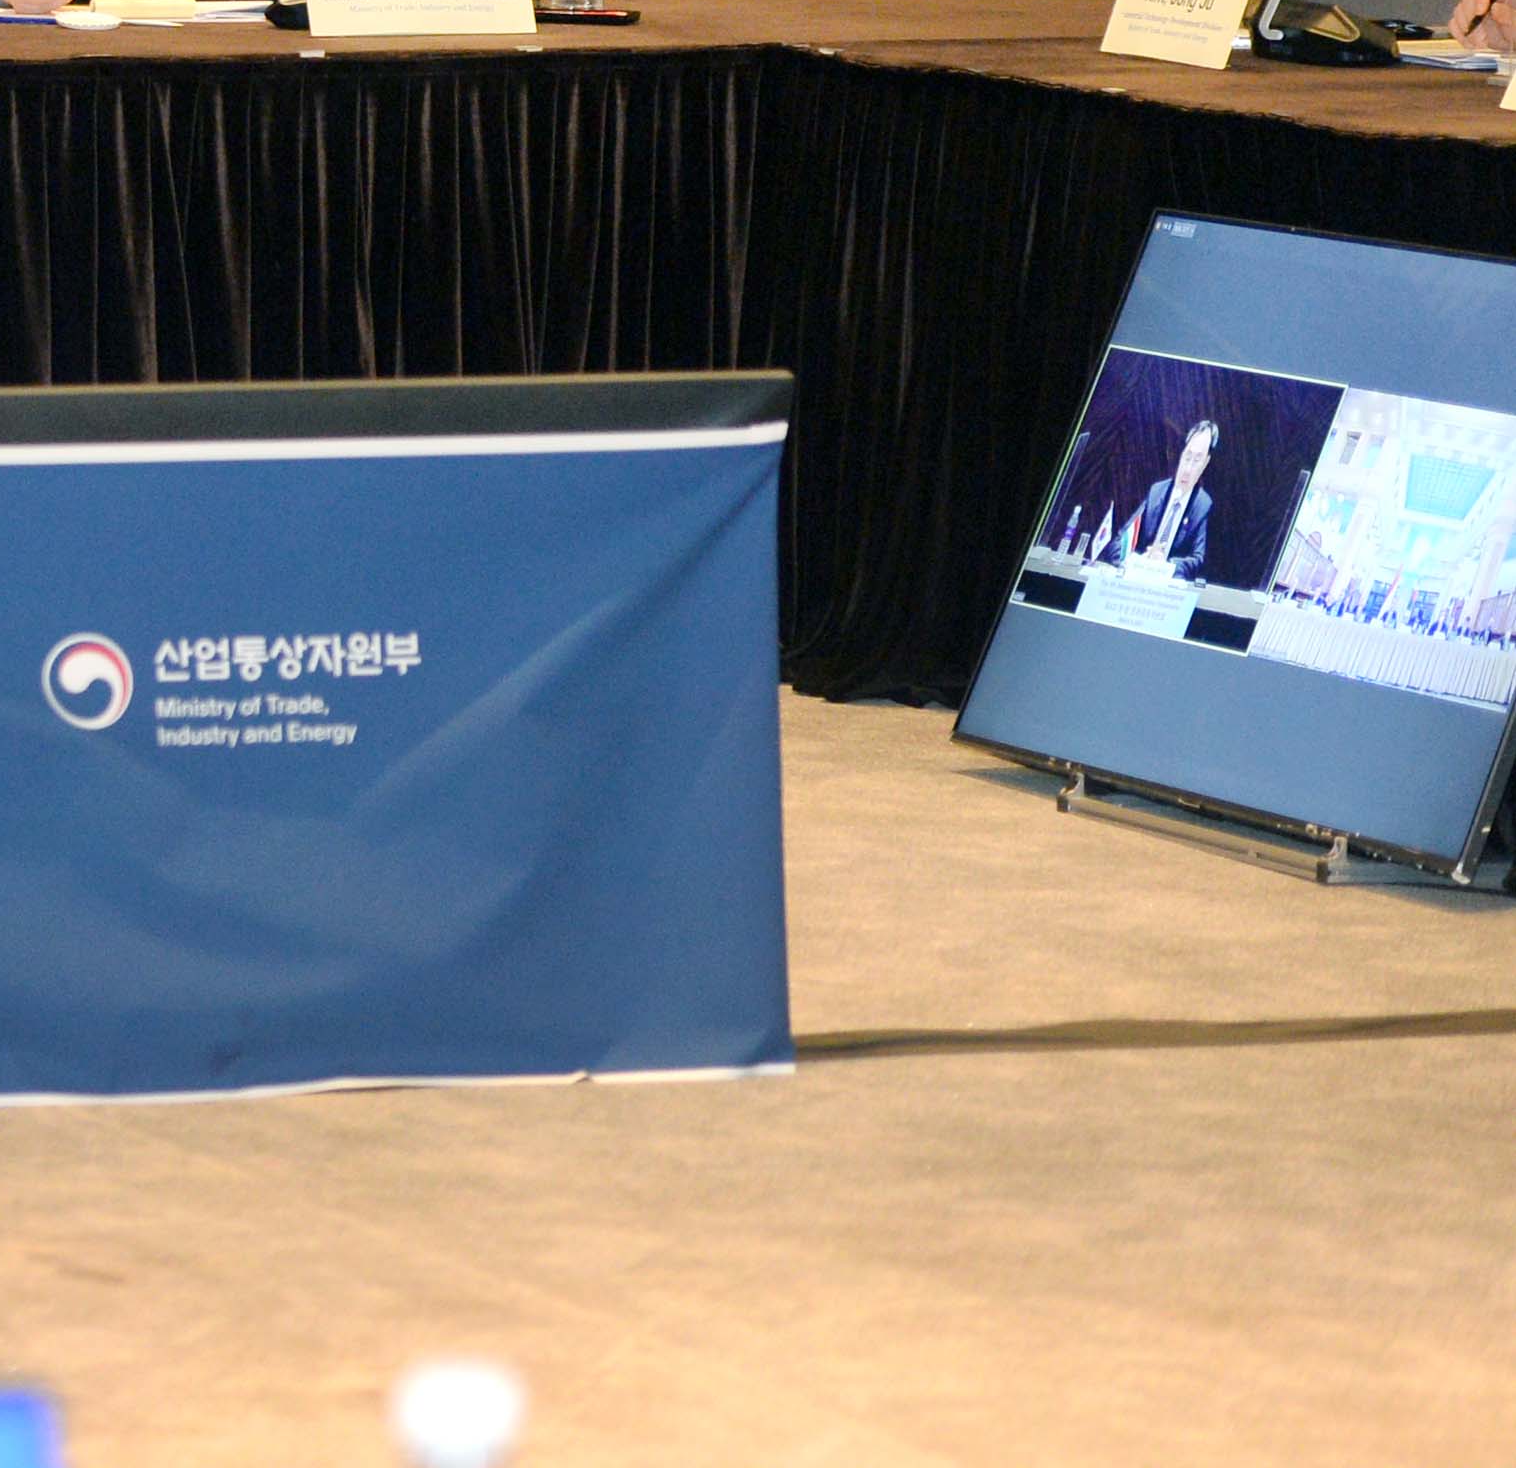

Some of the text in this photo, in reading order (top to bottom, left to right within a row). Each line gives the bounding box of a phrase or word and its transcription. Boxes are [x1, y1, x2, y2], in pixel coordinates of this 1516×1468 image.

[155, 633, 422, 682] 산업통상자원부
[156, 696, 328, 718] Ministry of Trade,
[158, 723, 356, 746] Industry and Energy
